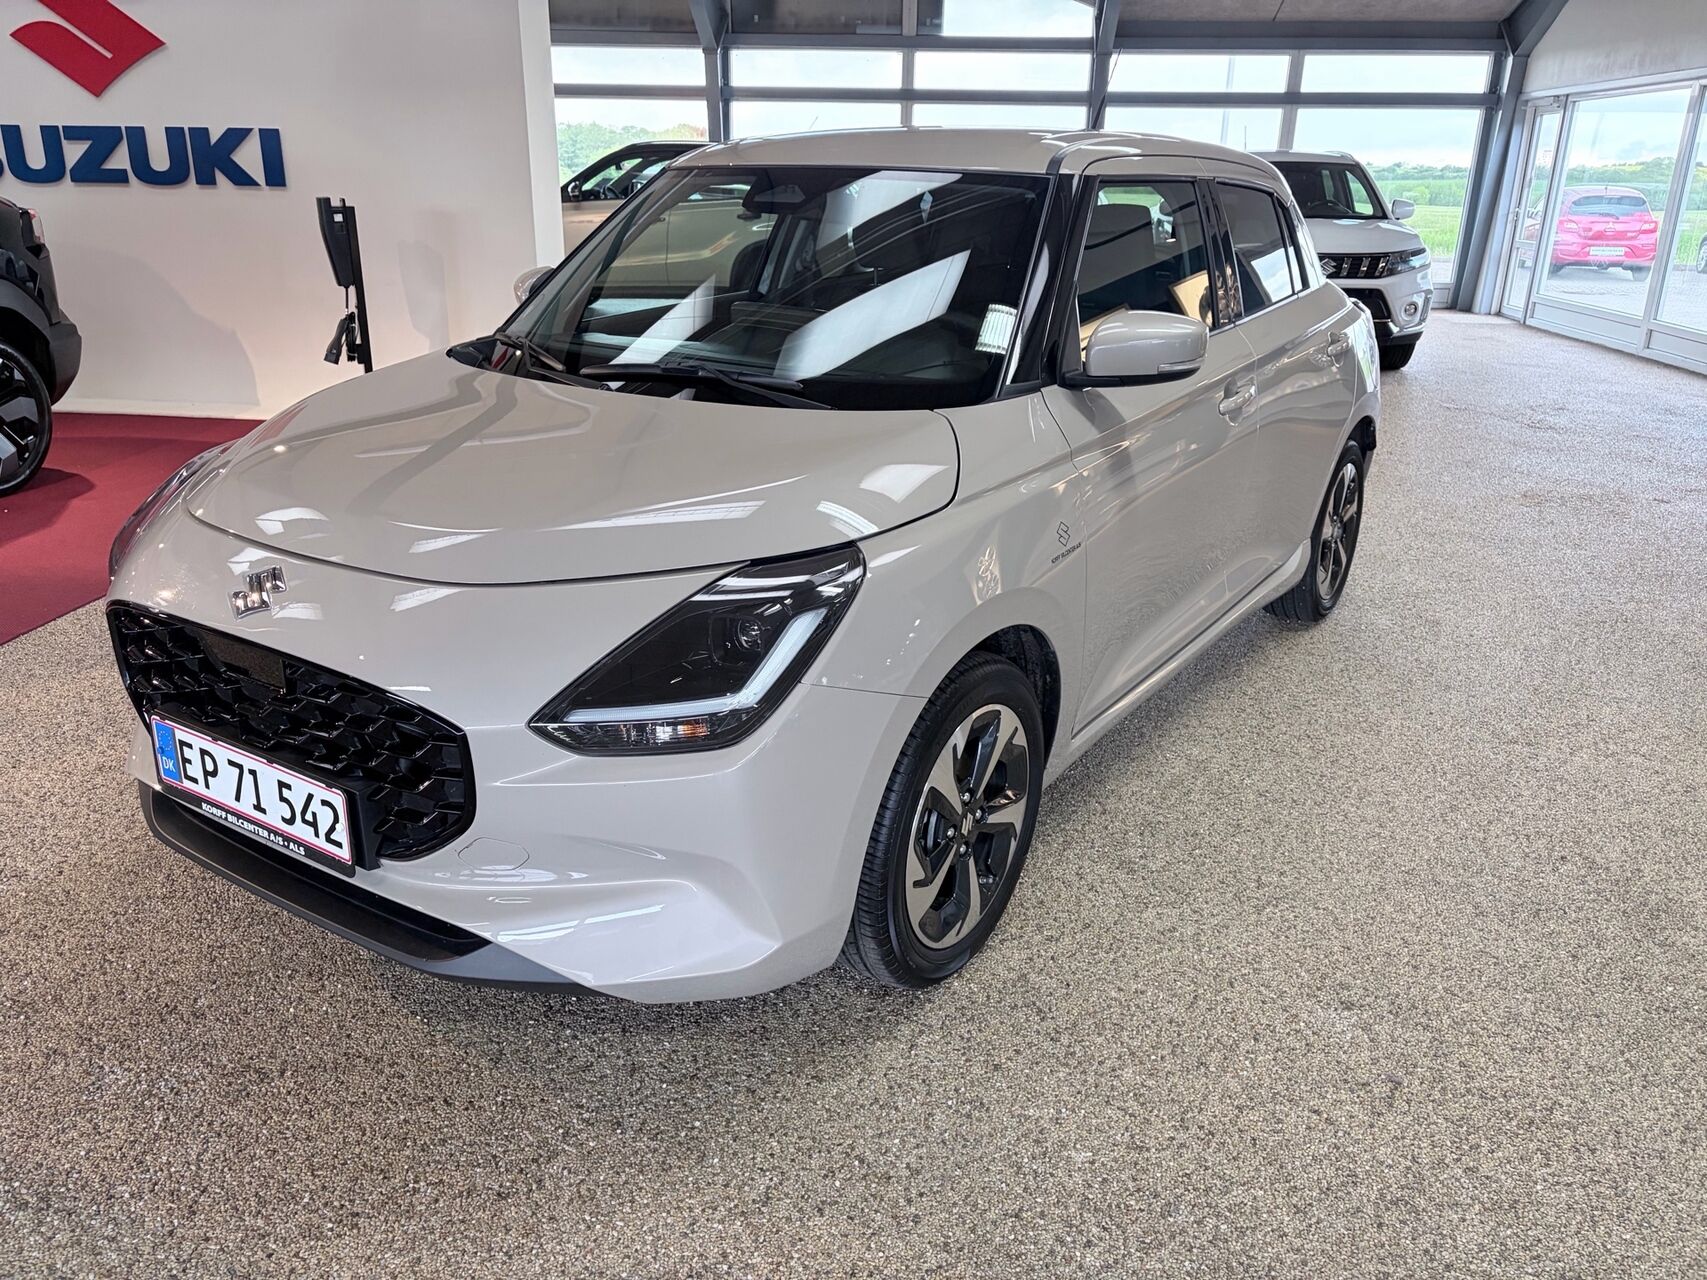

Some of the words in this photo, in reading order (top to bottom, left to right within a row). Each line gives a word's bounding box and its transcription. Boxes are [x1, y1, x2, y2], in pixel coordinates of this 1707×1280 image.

[0, 124, 287, 188] UZUKI
[161, 756, 176, 773] DK
[178, 738, 219, 790] EP
[226, 758, 268, 816] 71
[276, 778, 344, 850] 542
[201, 802, 227, 819] KORFF
[227, 813, 269, 840] BILCENTER
[289, 841, 306, 856] ALS
